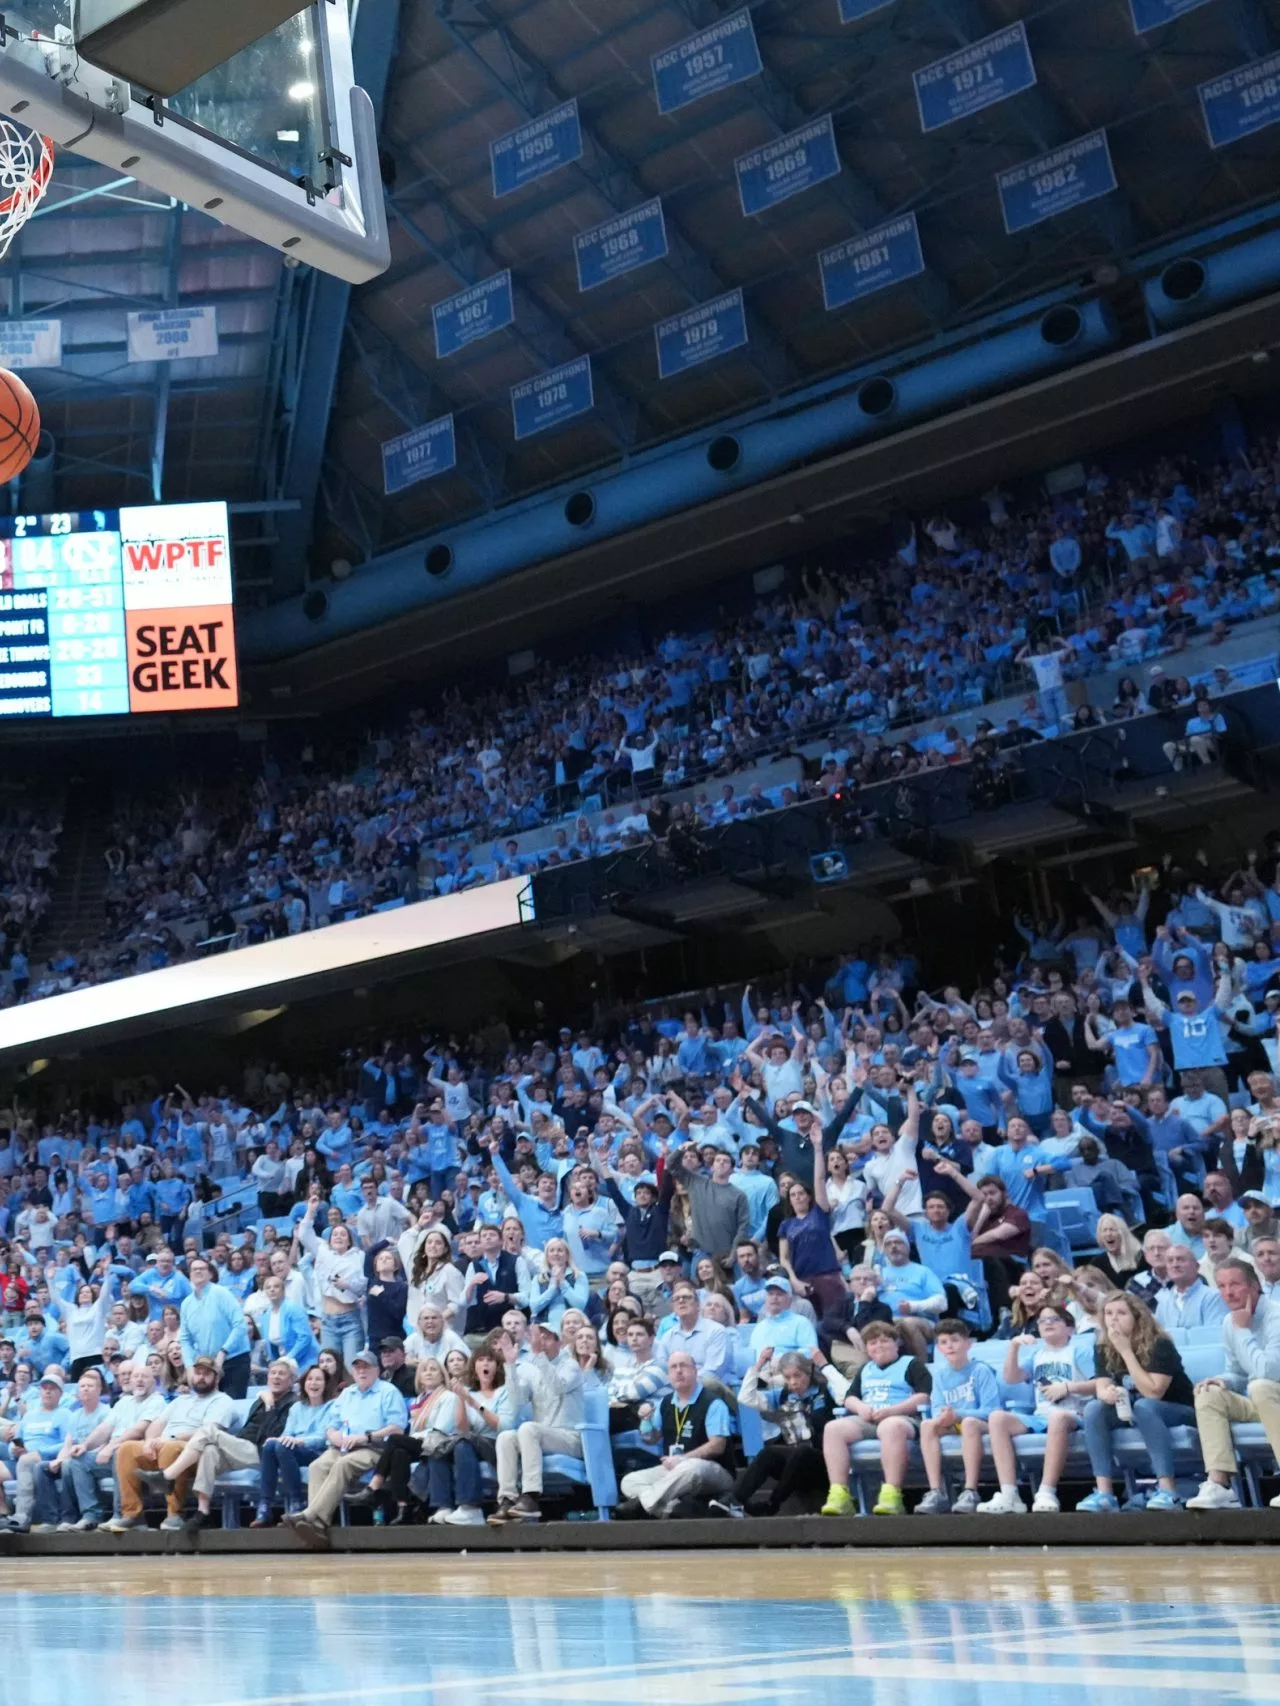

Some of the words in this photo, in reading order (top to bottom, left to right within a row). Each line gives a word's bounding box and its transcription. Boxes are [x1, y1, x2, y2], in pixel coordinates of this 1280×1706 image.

[656, 53, 677, 71] ACC
[680, 15, 748, 60] CHAMPIONS
[919, 66, 945, 87] ACC
[946, 30, 1021, 75] CHAMPIONS
[685, 45, 724, 77] 1957
[952, 60, 994, 92] 1971
[1203, 79, 1232, 101] ACC
[515, 106, 575, 145] CHAMPIONS
[739, 156, 761, 174] ACC
[763, 120, 829, 163] CHAMPIONS
[1028, 135, 1103, 177] CHAMPIONS
[1032, 164, 1078, 196] 1982
[577, 234, 598, 250] ACC
[599, 203, 659, 241] CHAMPIONS
[823, 251, 846, 267] ACC
[847, 220, 912, 257] CHAMPIONS
[455, 275, 509, 310] CHAMPIONS
[680, 294, 739, 329] CHAMPIONS
[683, 319, 718, 346] 1979
[533, 361, 587, 391] CHAMPIONS
[50, 513, 71, 534] 23
[127, 539, 224, 572] WPTF
[136, 620, 224, 658] SEAT
[132, 656, 231, 694] GEEK
